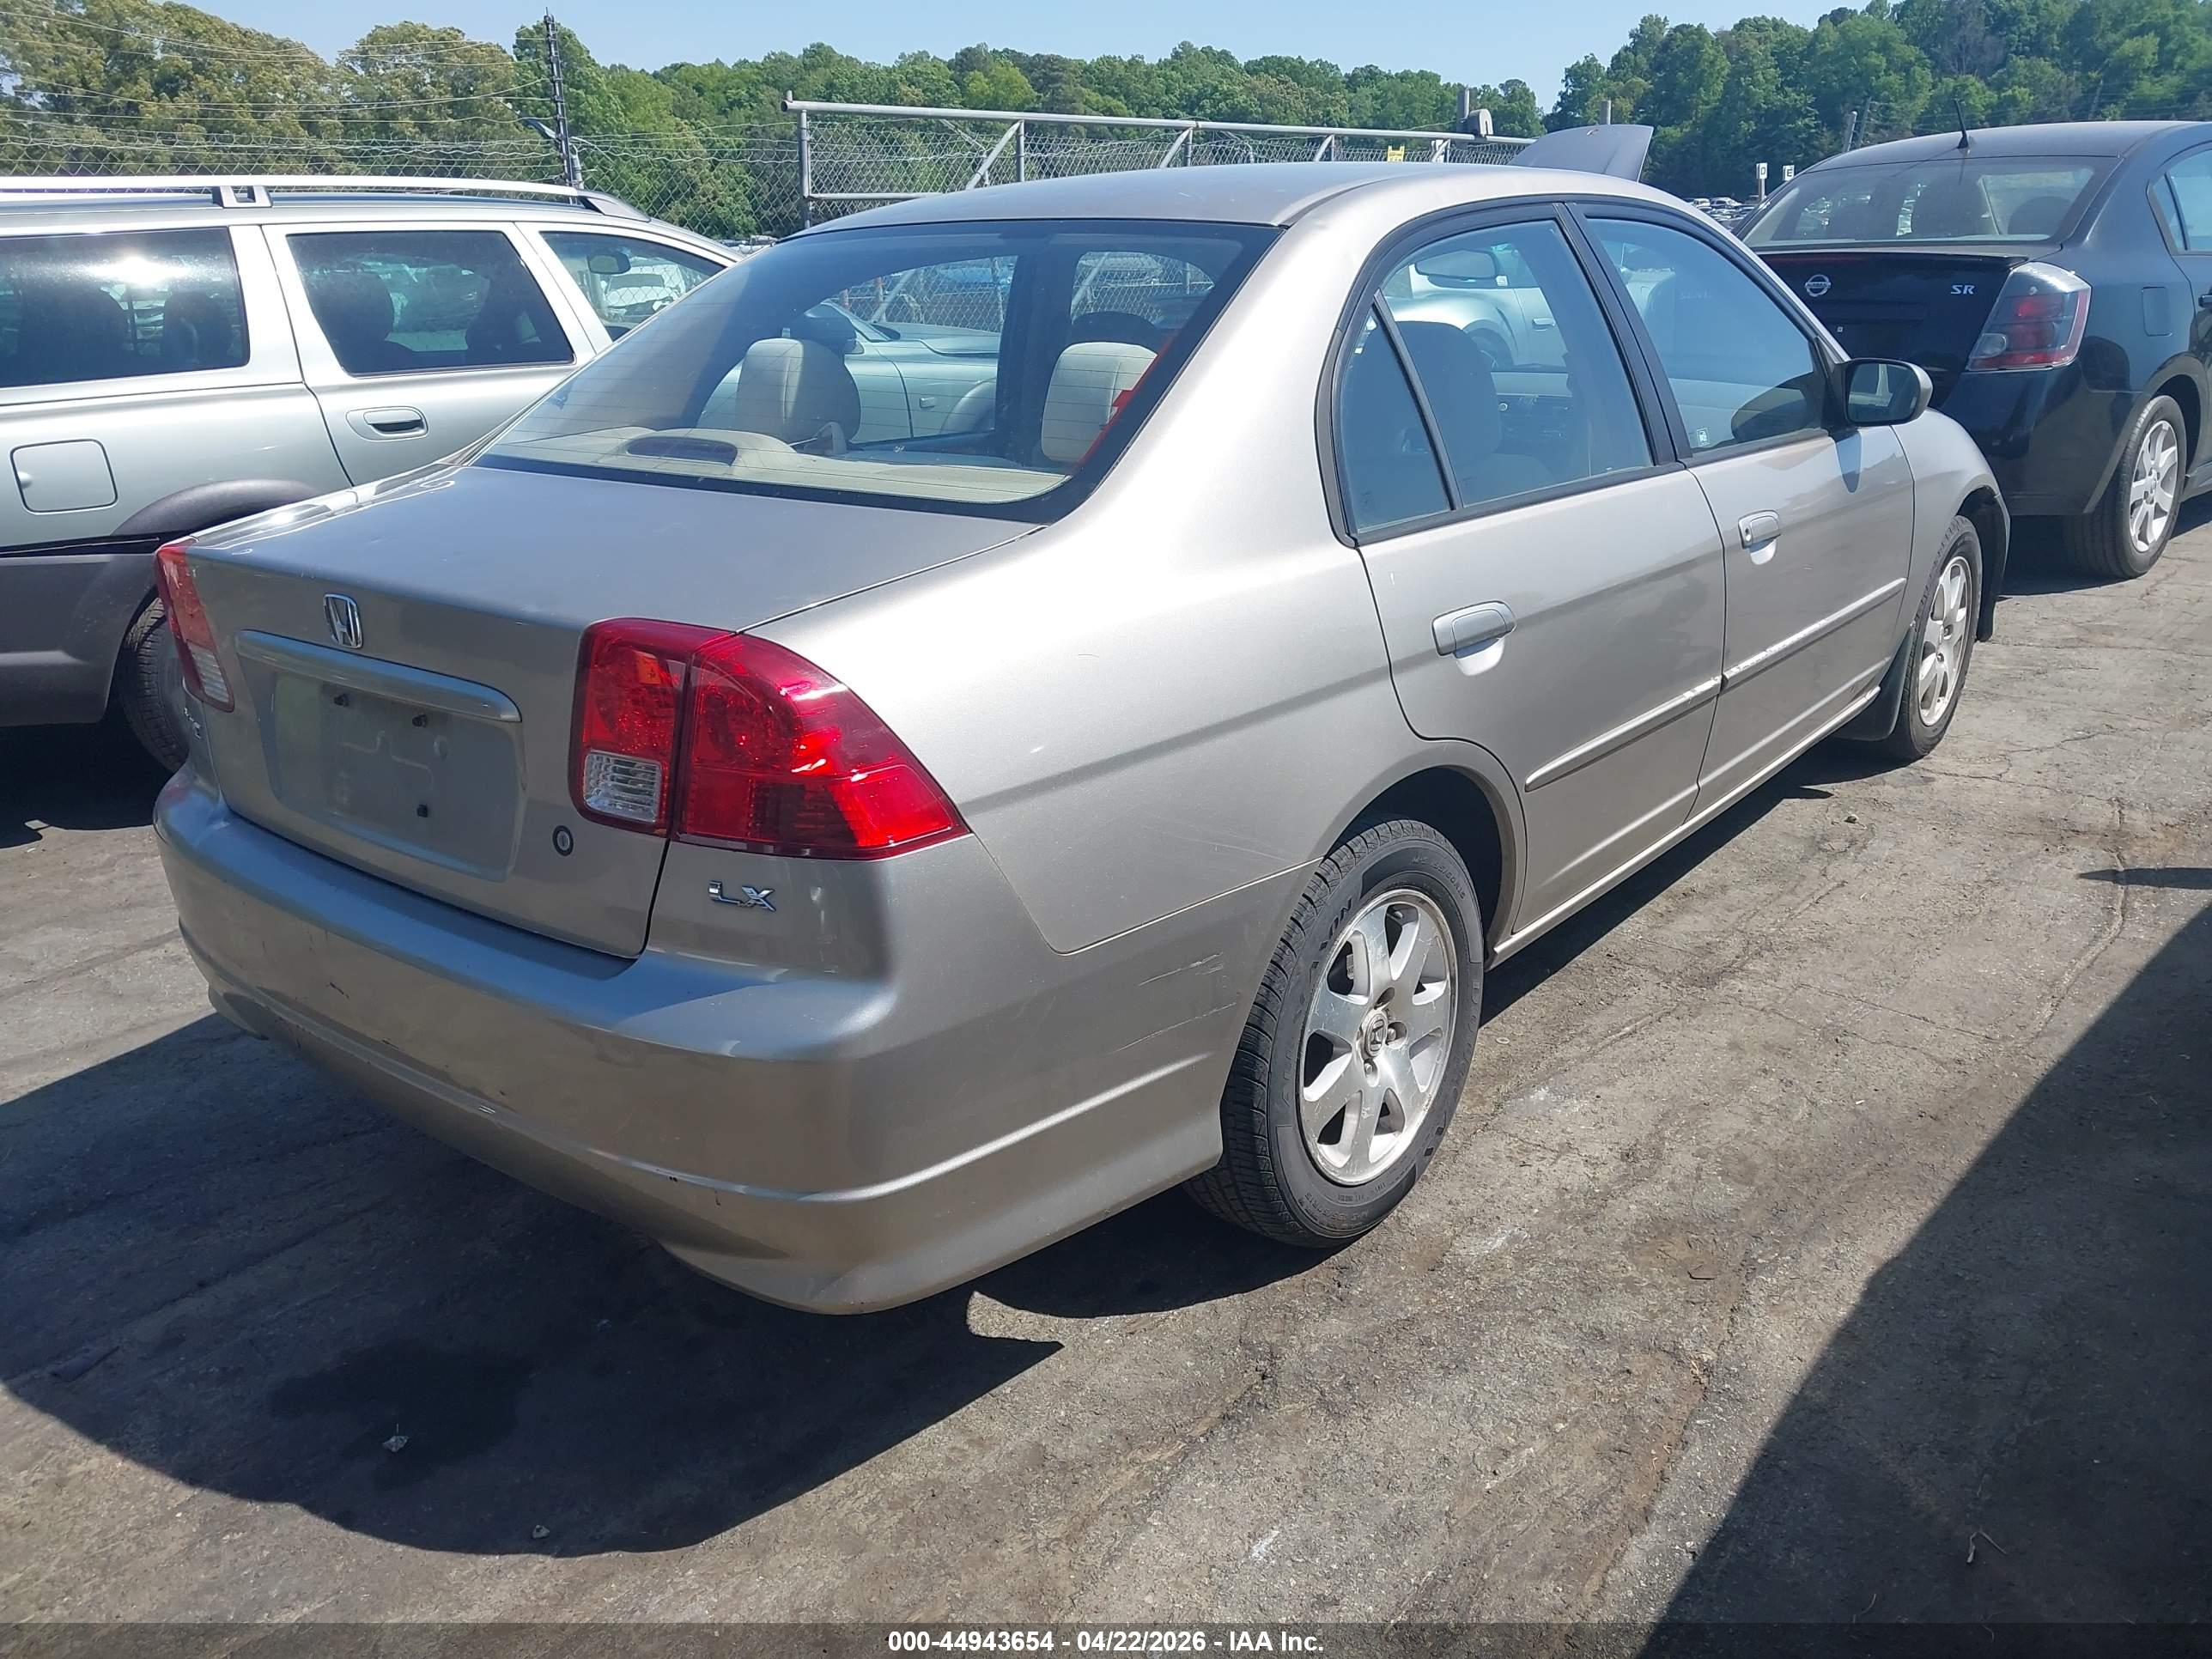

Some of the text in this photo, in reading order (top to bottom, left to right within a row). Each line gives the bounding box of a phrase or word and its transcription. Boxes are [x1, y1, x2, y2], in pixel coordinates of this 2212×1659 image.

[1787, 168, 1793, 177] E
[1950, 284, 1975, 295] SR
[708, 881, 776, 912] LX
